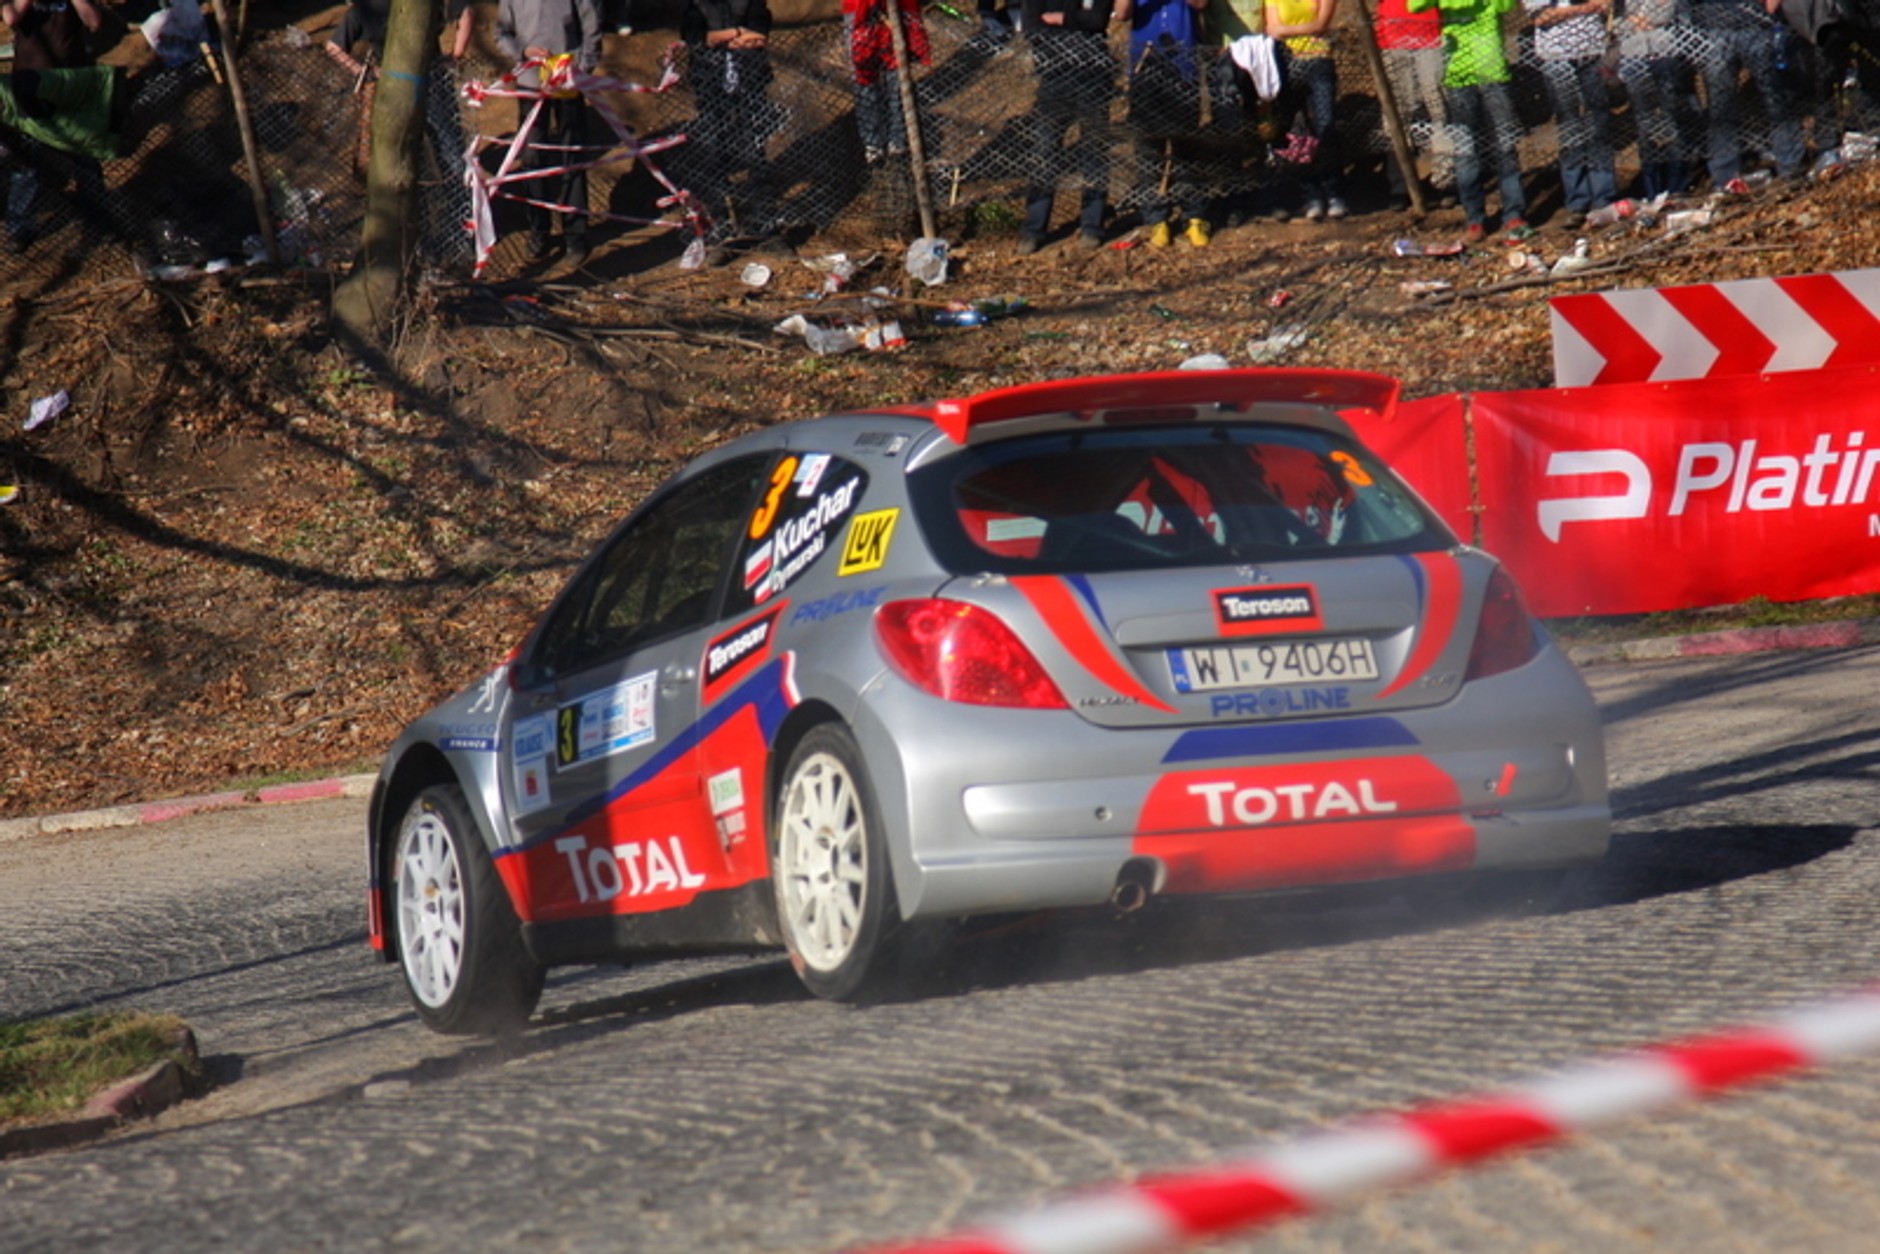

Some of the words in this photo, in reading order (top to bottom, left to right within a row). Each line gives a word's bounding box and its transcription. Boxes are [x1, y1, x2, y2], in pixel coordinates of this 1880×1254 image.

[1330, 450, 1374, 487] 3
[749, 455, 799, 540] 3
[772, 476, 860, 567] Kuchar
[1222, 595, 1311, 618] Teroson
[709, 621, 769, 675] Teroson
[1191, 647, 1241, 684] WI
[1257, 640, 1373, 680] 9406H
[1209, 686, 1352, 718] PROLINE
[560, 706, 574, 763] 3
[1186, 778, 1398, 827] TOTAL
[554, 834, 707, 904] TOTAL
